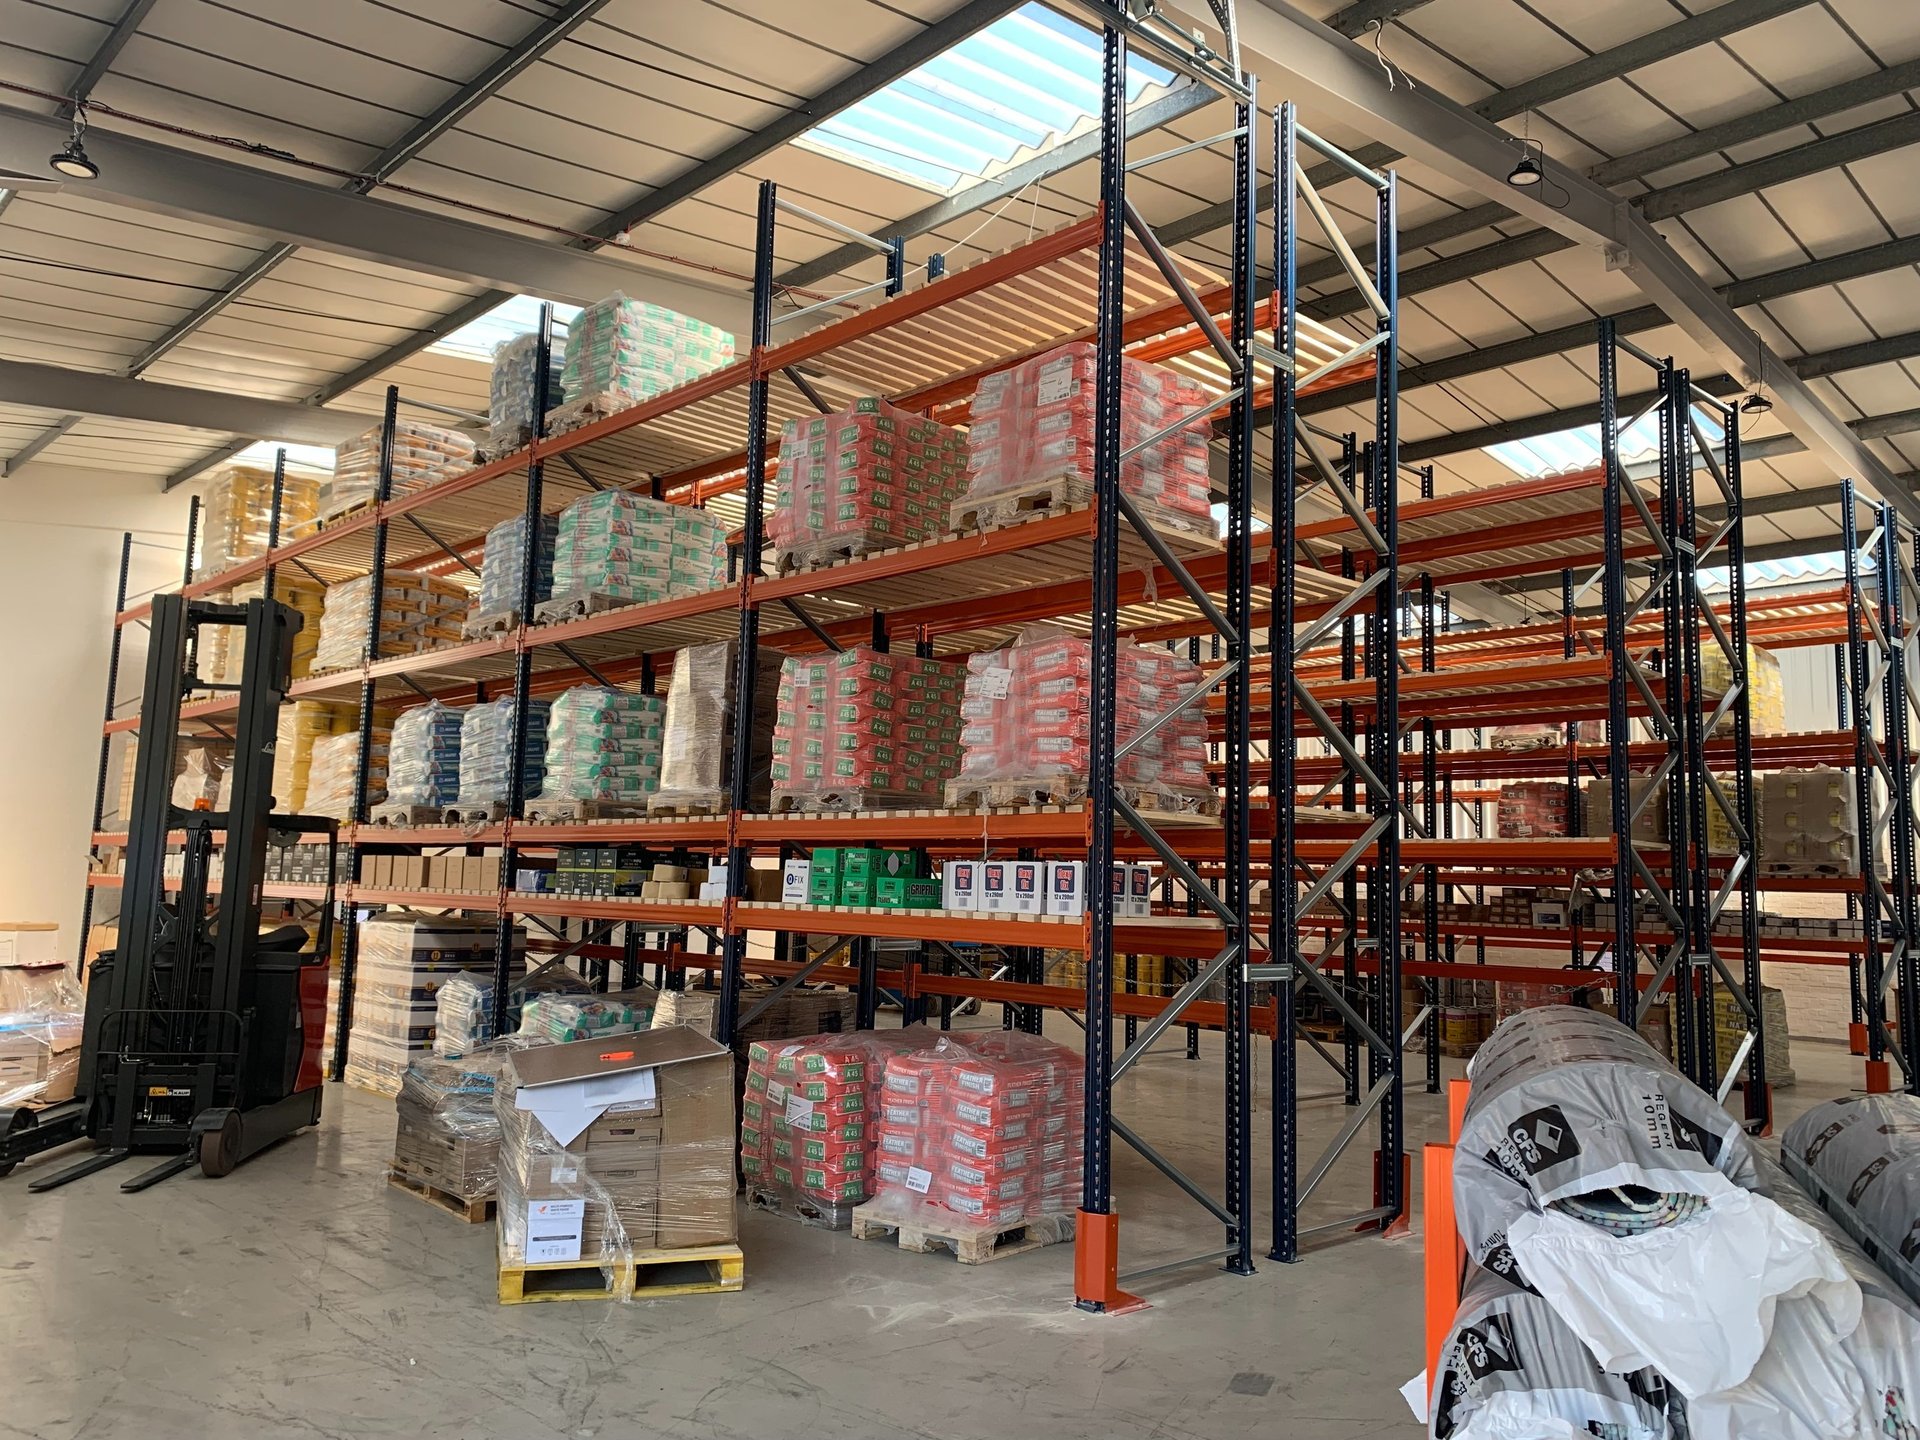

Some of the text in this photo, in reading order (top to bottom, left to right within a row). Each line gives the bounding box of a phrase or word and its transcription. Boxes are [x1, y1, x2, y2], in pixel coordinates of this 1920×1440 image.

[852, 1069, 858, 1077] 45
[961, 1072, 983, 1083] FEATHER
[961, 1079, 980, 1089] FINISH
[851, 1099, 858, 1107] 45
[960, 1103, 980, 1116] FEATHER
[1642, 1094, 1661, 1150] 10mm
[1655, 1094, 1673, 1149] REGENT
[850, 1129, 858, 1137] 45
[954, 1134, 975, 1147] FEATHER
[1513, 1128, 1542, 1164] CFS
[851, 1159, 858, 1167] 45
[1492, 1248, 1515, 1274] CFS
[1467, 1332, 1489, 1368] CFS
